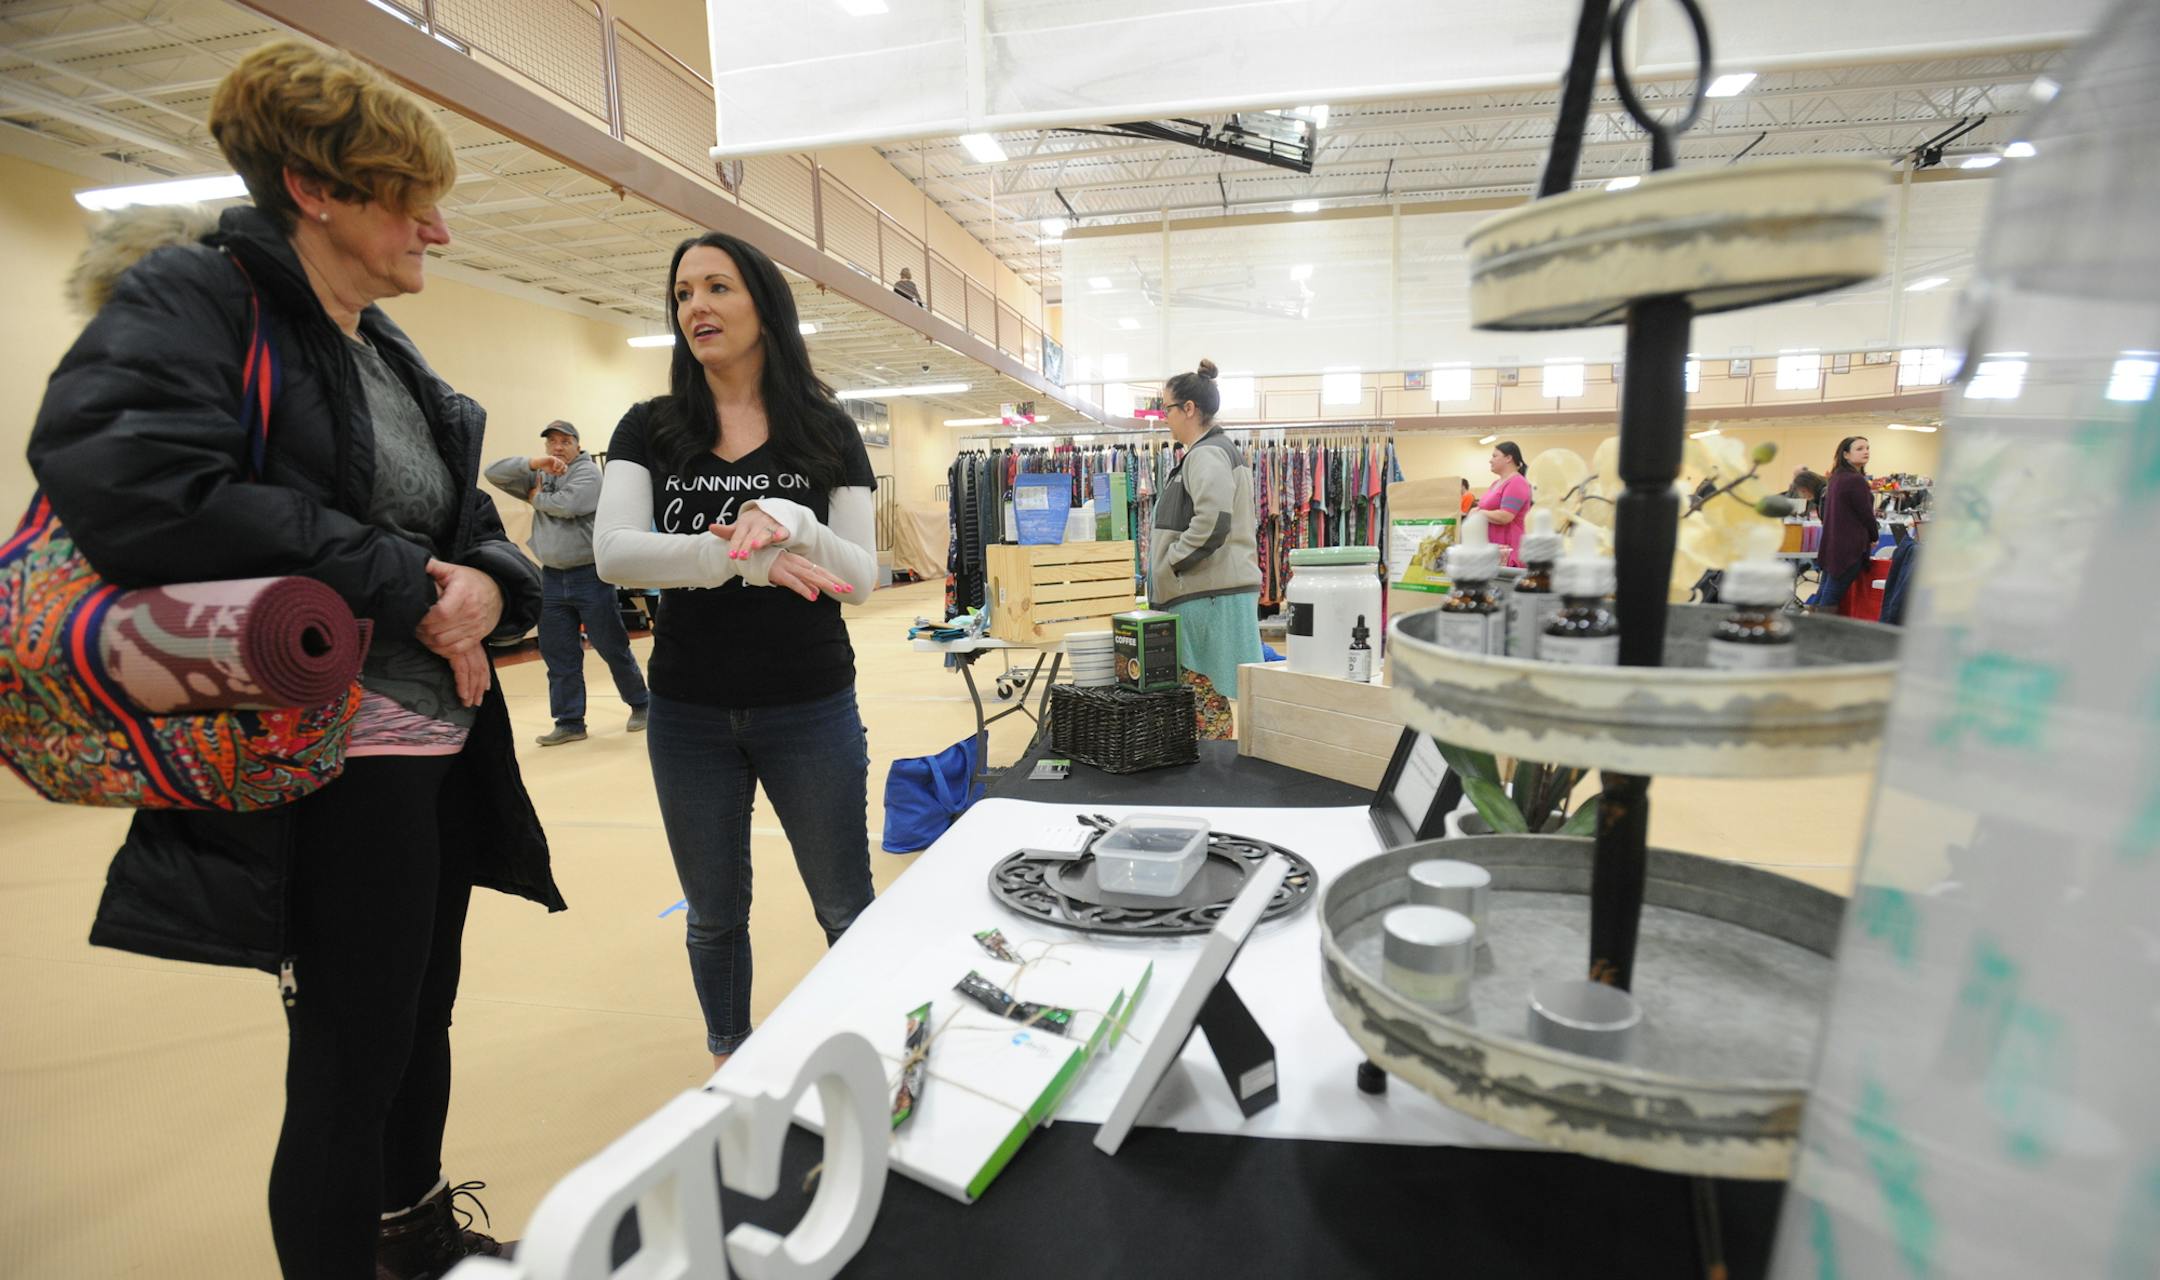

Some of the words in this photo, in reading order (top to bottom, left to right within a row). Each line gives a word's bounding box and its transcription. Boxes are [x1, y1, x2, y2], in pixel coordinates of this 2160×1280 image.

[665, 474, 770, 491] RUNNING
[777, 473, 810, 489] ON
[1115, 636, 1136, 646] COFFEE
